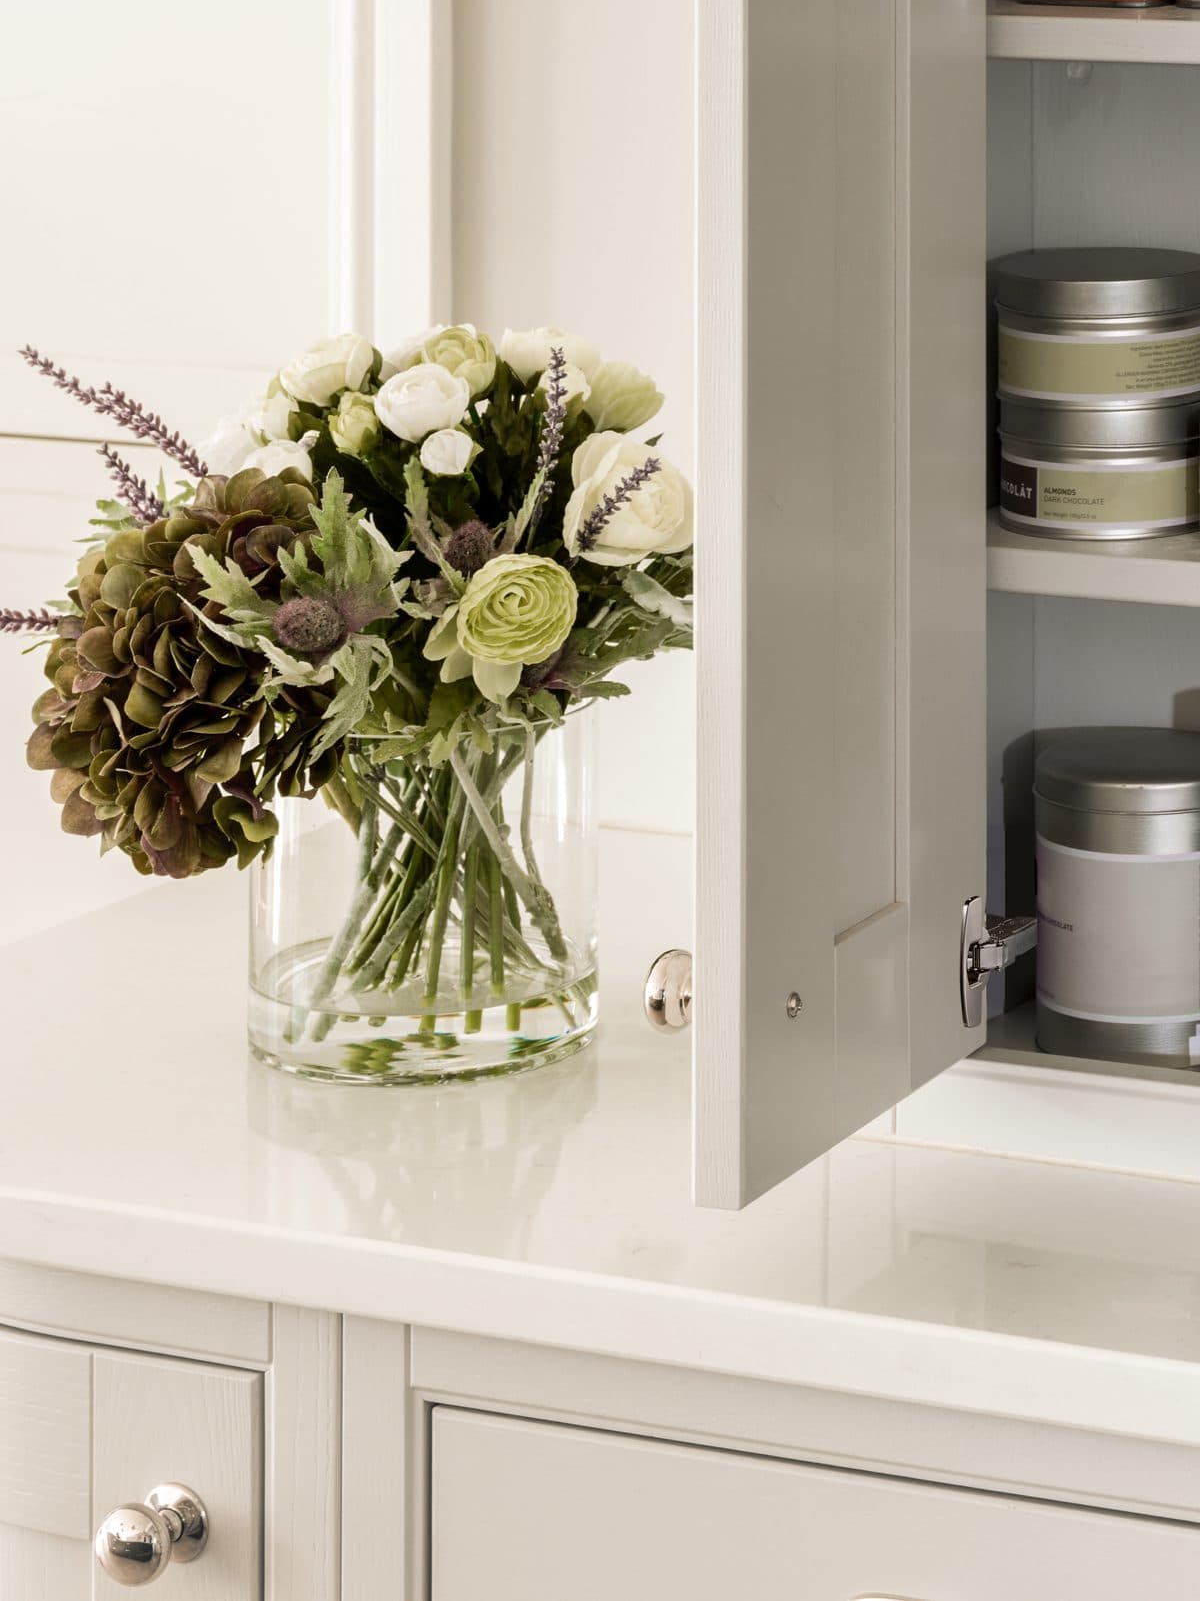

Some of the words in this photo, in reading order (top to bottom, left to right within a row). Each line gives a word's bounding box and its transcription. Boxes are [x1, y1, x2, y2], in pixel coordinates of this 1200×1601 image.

[1043, 486, 1077, 496] ALMONDS
[1043, 496, 1062, 504] DARK
[1063, 496, 1105, 505] CHOCOLATE
